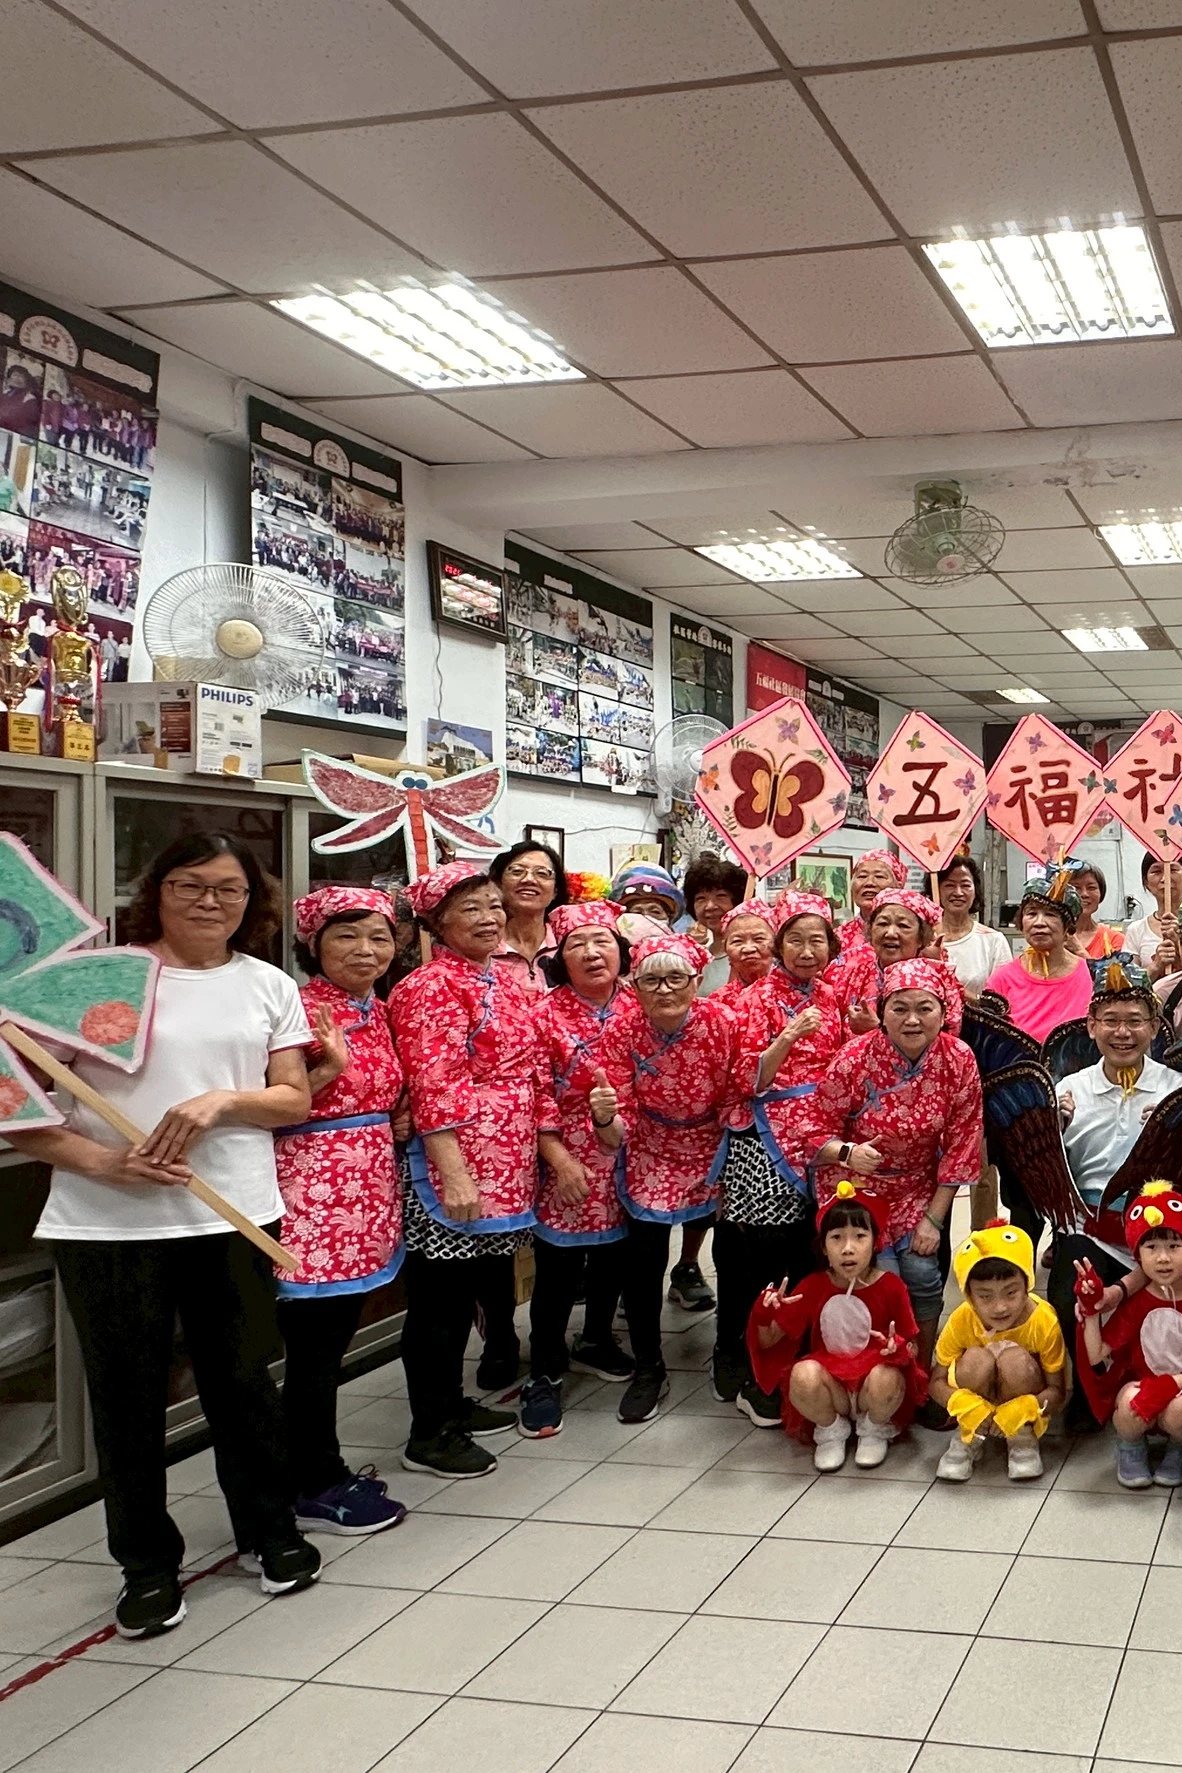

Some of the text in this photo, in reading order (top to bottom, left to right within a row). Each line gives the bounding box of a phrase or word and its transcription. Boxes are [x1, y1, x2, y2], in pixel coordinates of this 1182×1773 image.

[201, 687, 254, 706] PHILIPS
[892, 761, 961, 828] 五
[1004, 758, 1079, 831] 福
